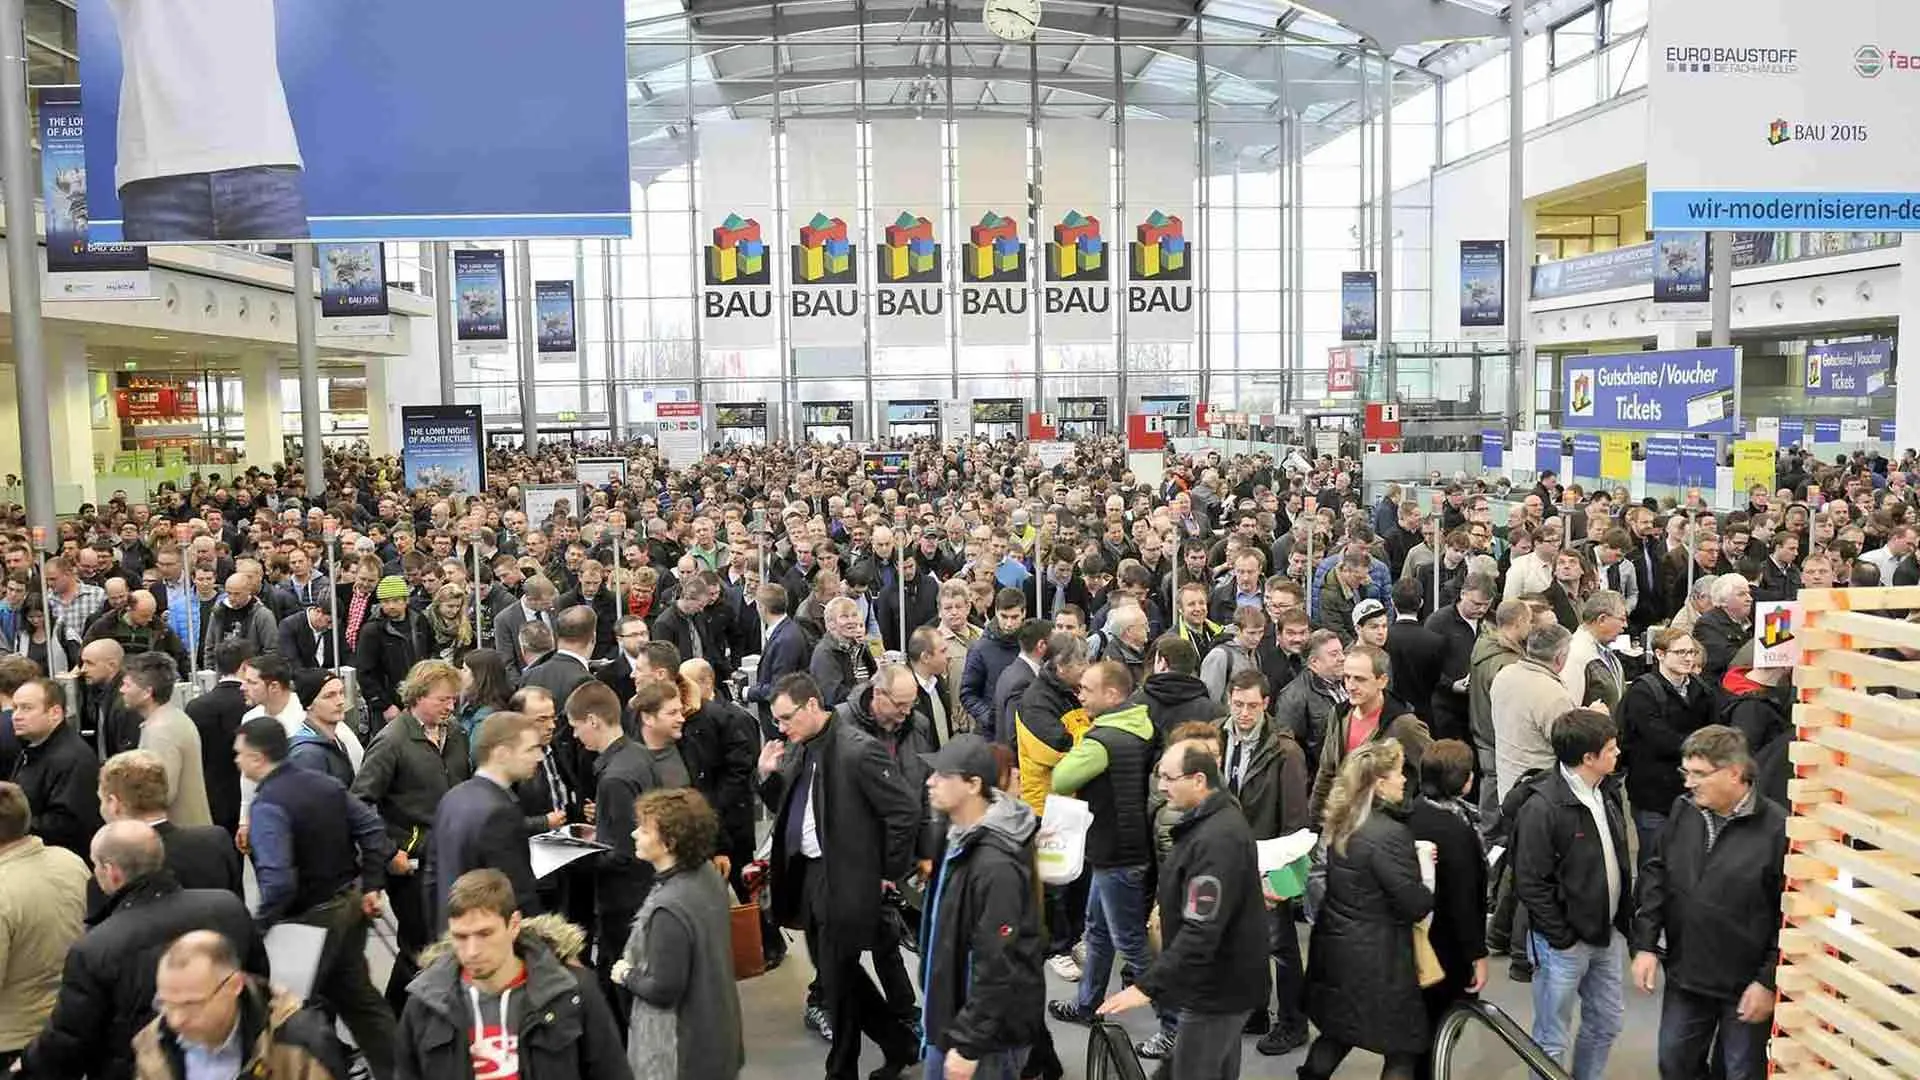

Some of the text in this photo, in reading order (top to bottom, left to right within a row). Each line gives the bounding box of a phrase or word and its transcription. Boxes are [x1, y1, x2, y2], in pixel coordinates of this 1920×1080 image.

[1713, 47, 1798, 62] BAUSTOFF
[46, 127, 60, 137] OF
[48, 117, 67, 127] THE
[1794, 124, 1868, 142] BAU 2015
[704, 290, 772, 318] BAU
[792, 289, 858, 317] BAU
[877, 288, 943, 316] BAU
[962, 288, 1027, 315] BAU
[1045, 287, 1109, 313] BAU
[1128, 286, 1192, 313] BAU
[1616, 392, 1663, 421] Tickets
[408, 435, 471, 444] OF ARCHITECTURE
[409, 427, 469, 436] THE LONG NIGHT
